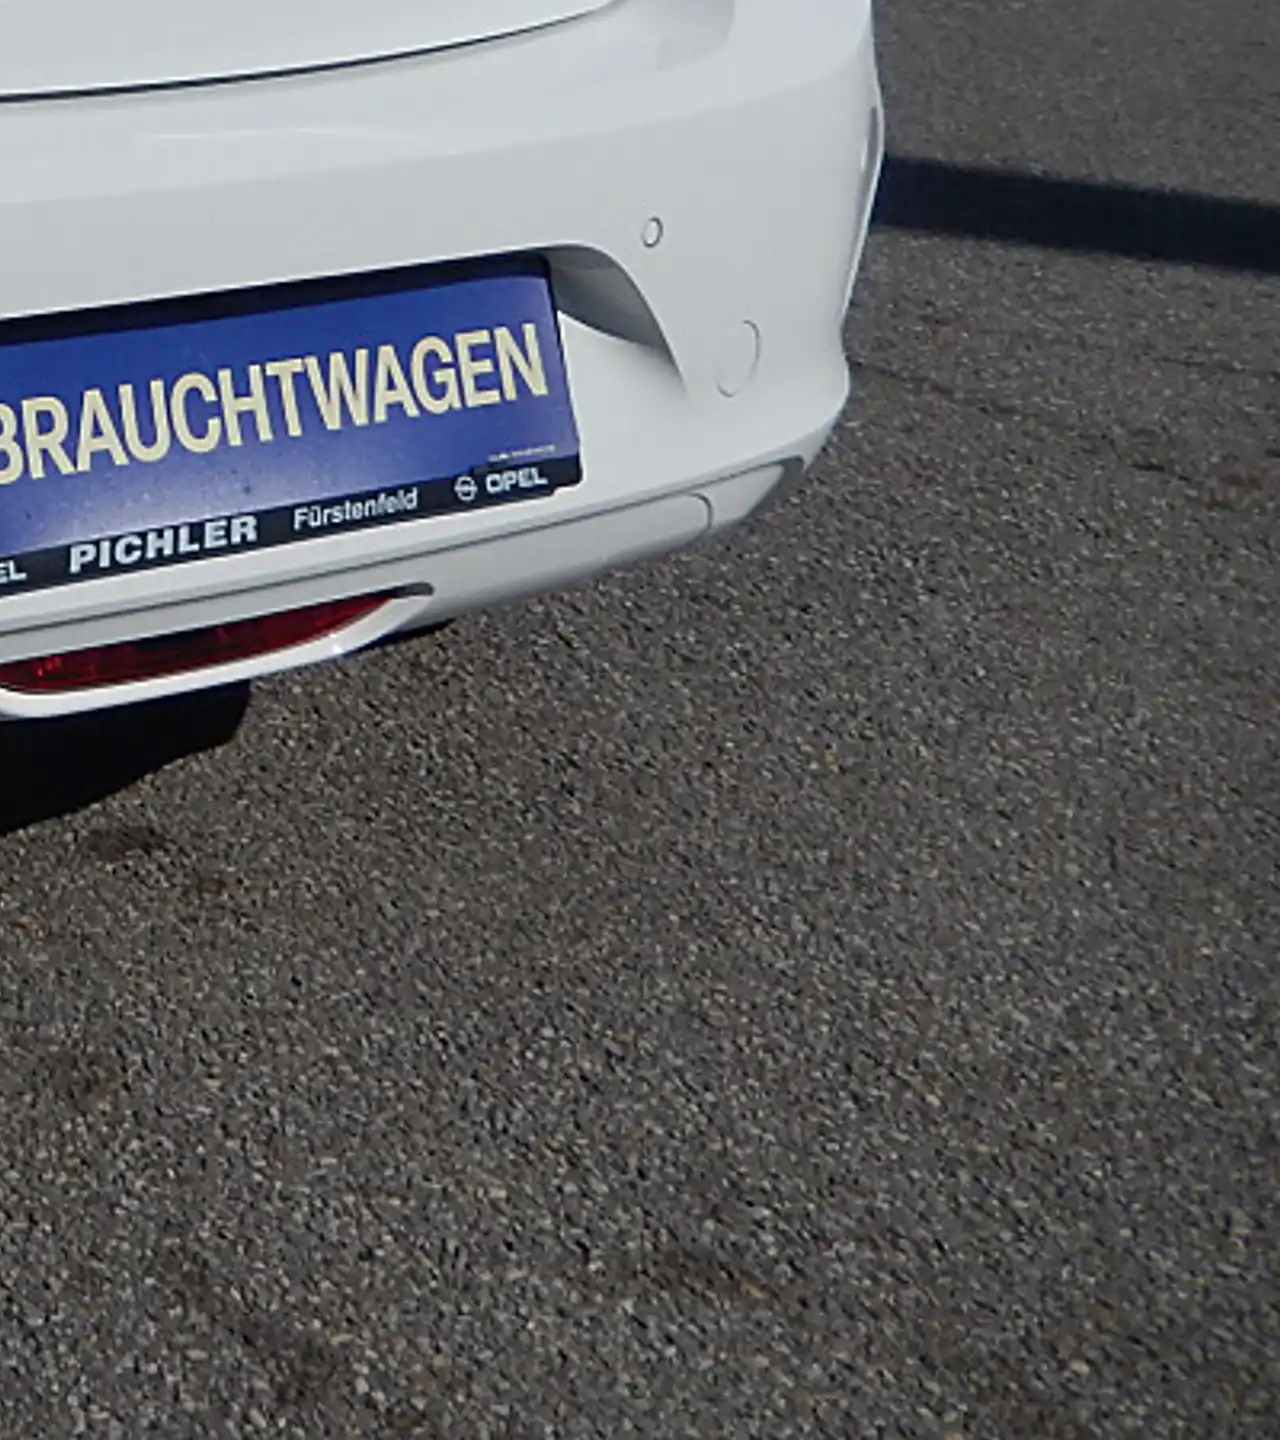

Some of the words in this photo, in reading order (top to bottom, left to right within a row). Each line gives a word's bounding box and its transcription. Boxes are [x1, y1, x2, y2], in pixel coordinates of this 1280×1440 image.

[69, 515, 258, 574] PICHLER
[293, 487, 419, 531] Fürstenfeld
[485, 466, 549, 494] OPEL
